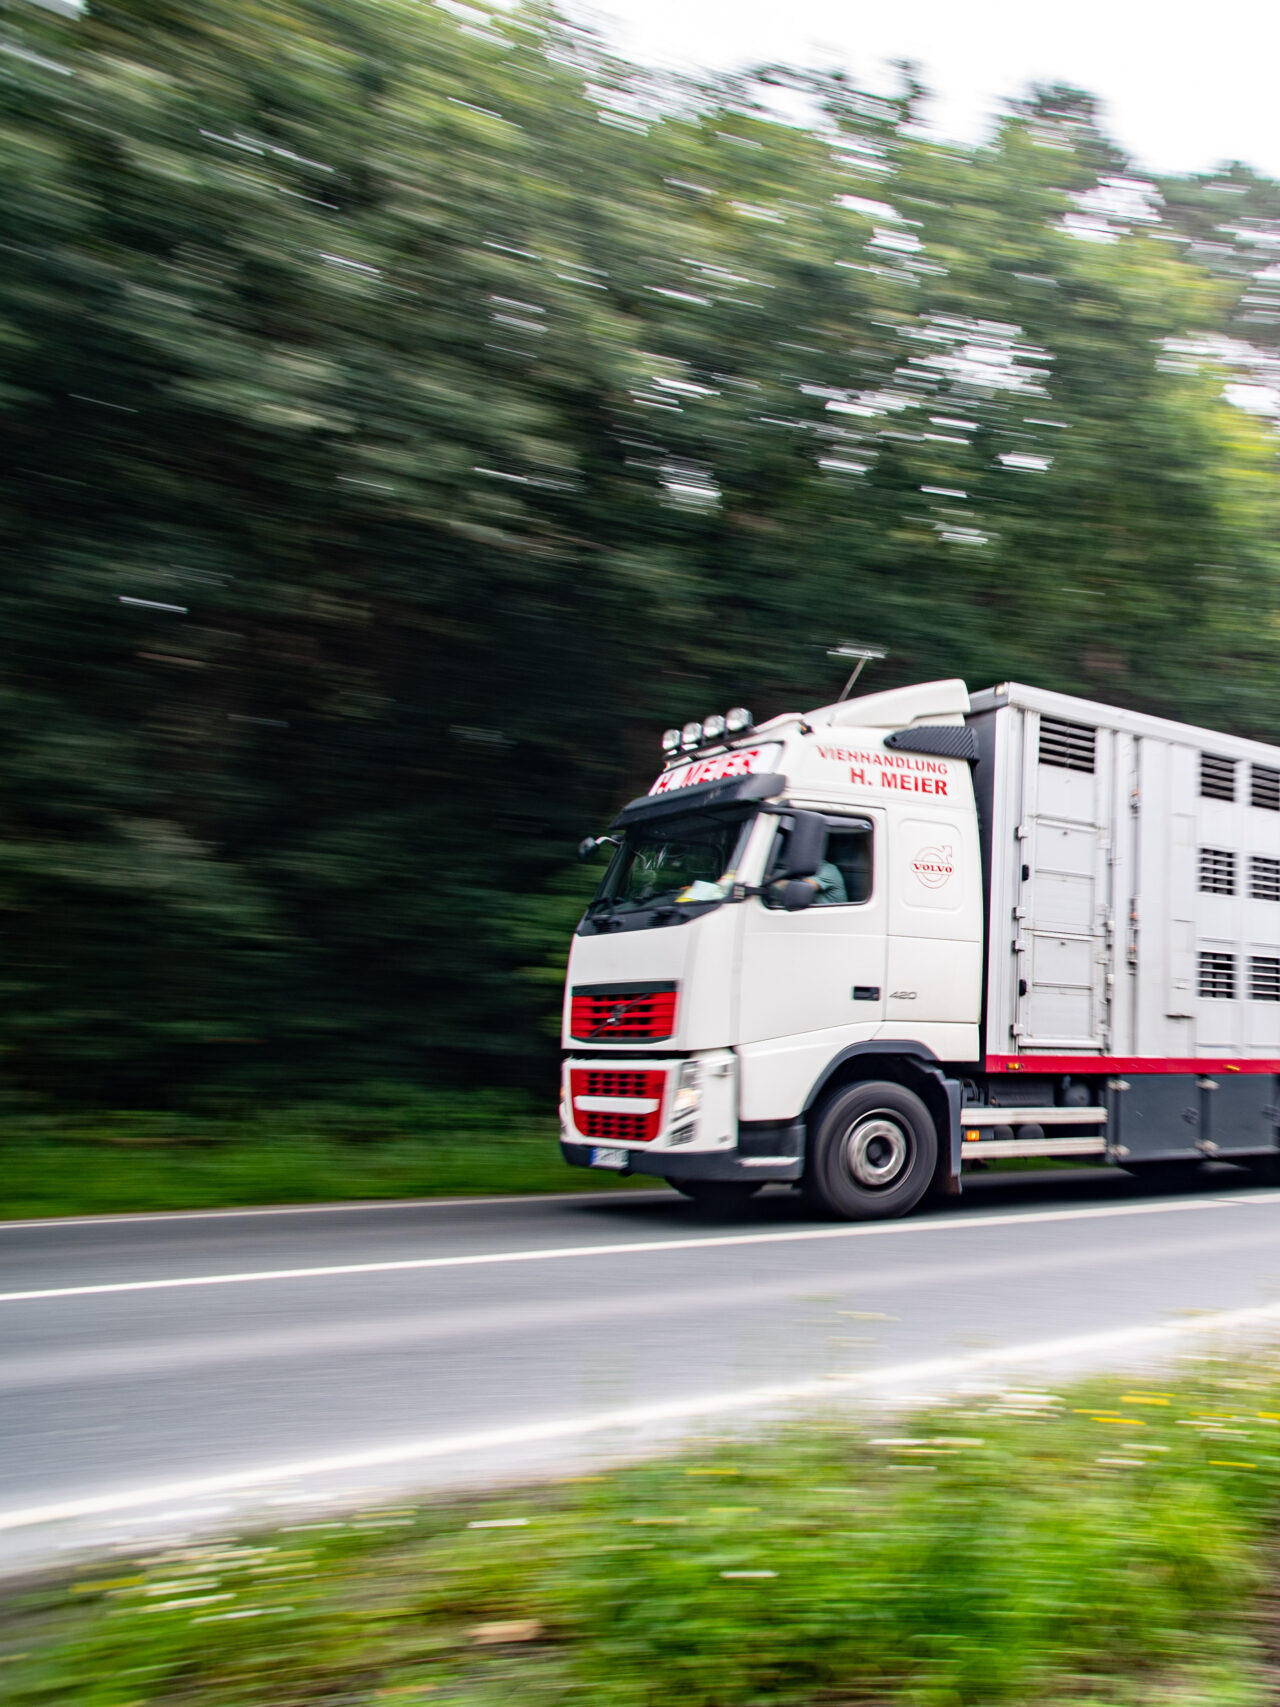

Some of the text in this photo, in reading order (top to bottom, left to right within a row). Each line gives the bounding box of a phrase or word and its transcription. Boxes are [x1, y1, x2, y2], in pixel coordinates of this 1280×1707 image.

[680, 750, 760, 788] MEIER
[816, 745, 948, 775] VIEHHANDLUNG
[849, 767, 948, 796] H. MEIER
[913, 863, 953, 873] VOLVO
[889, 991, 918, 1000] 420
